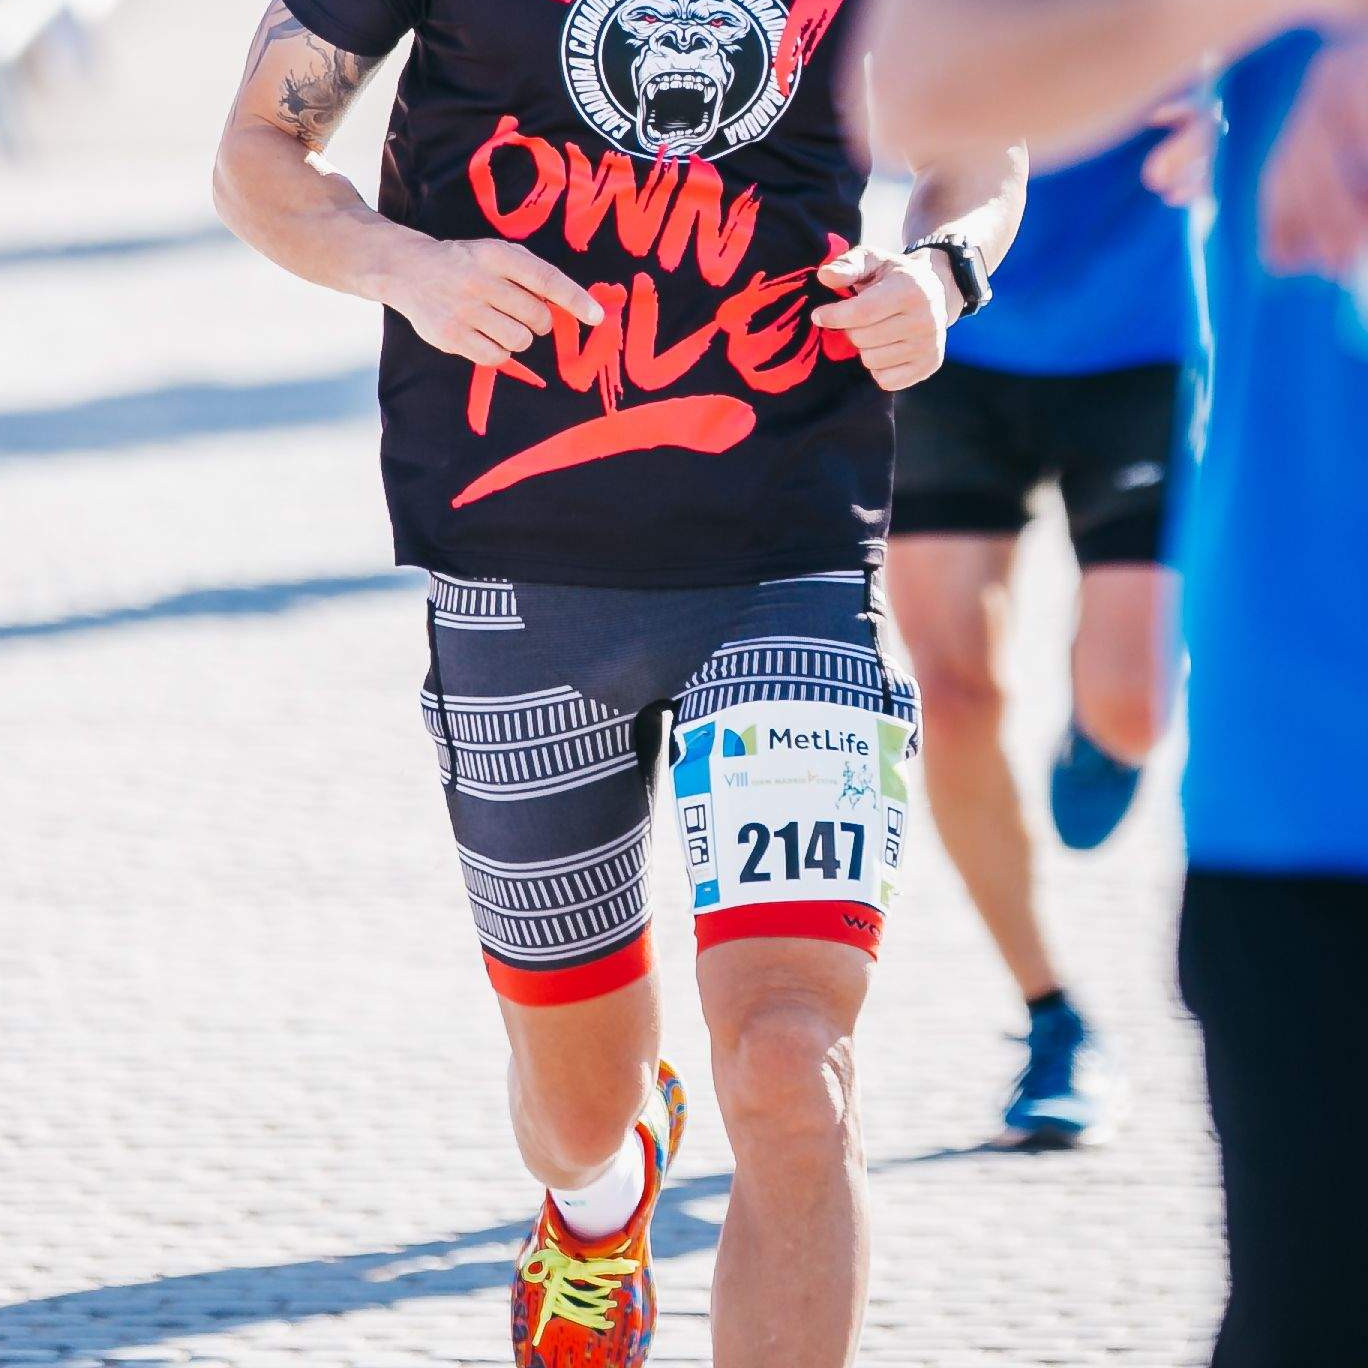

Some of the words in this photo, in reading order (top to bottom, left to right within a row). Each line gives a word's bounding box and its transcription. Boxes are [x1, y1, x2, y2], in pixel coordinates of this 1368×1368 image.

[568, 56, 631, 139] CARADURA
[468, 115, 762, 287] OWN
[768, 727, 870, 757] MetLife
[723, 771, 749, 789] VIII
[737, 820, 865, 884] 2147
